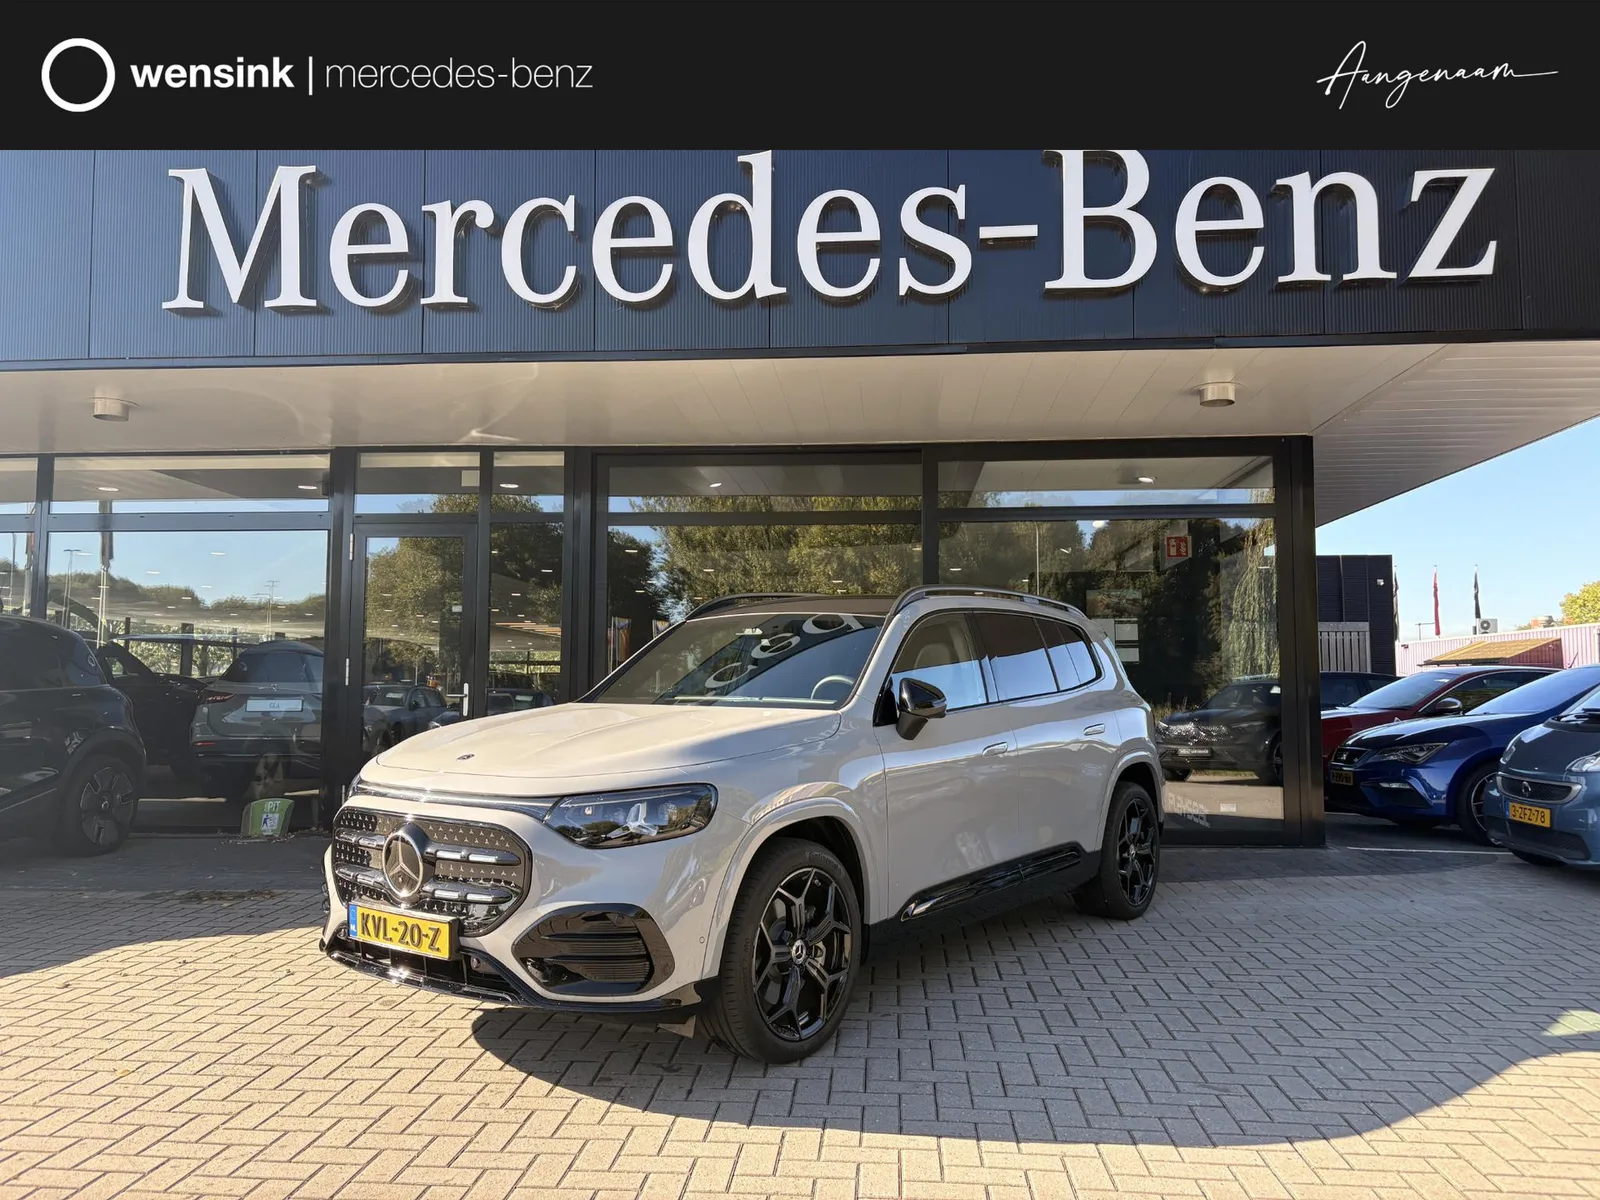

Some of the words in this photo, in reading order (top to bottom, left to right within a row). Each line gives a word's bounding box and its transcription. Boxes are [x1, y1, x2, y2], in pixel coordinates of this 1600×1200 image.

[162, 150, 1497, 310] Mercedes-Benz
[1511, 804, 1546, 824] 3-ZFZ-78
[361, 911, 442, 952] KVL-20-Z
